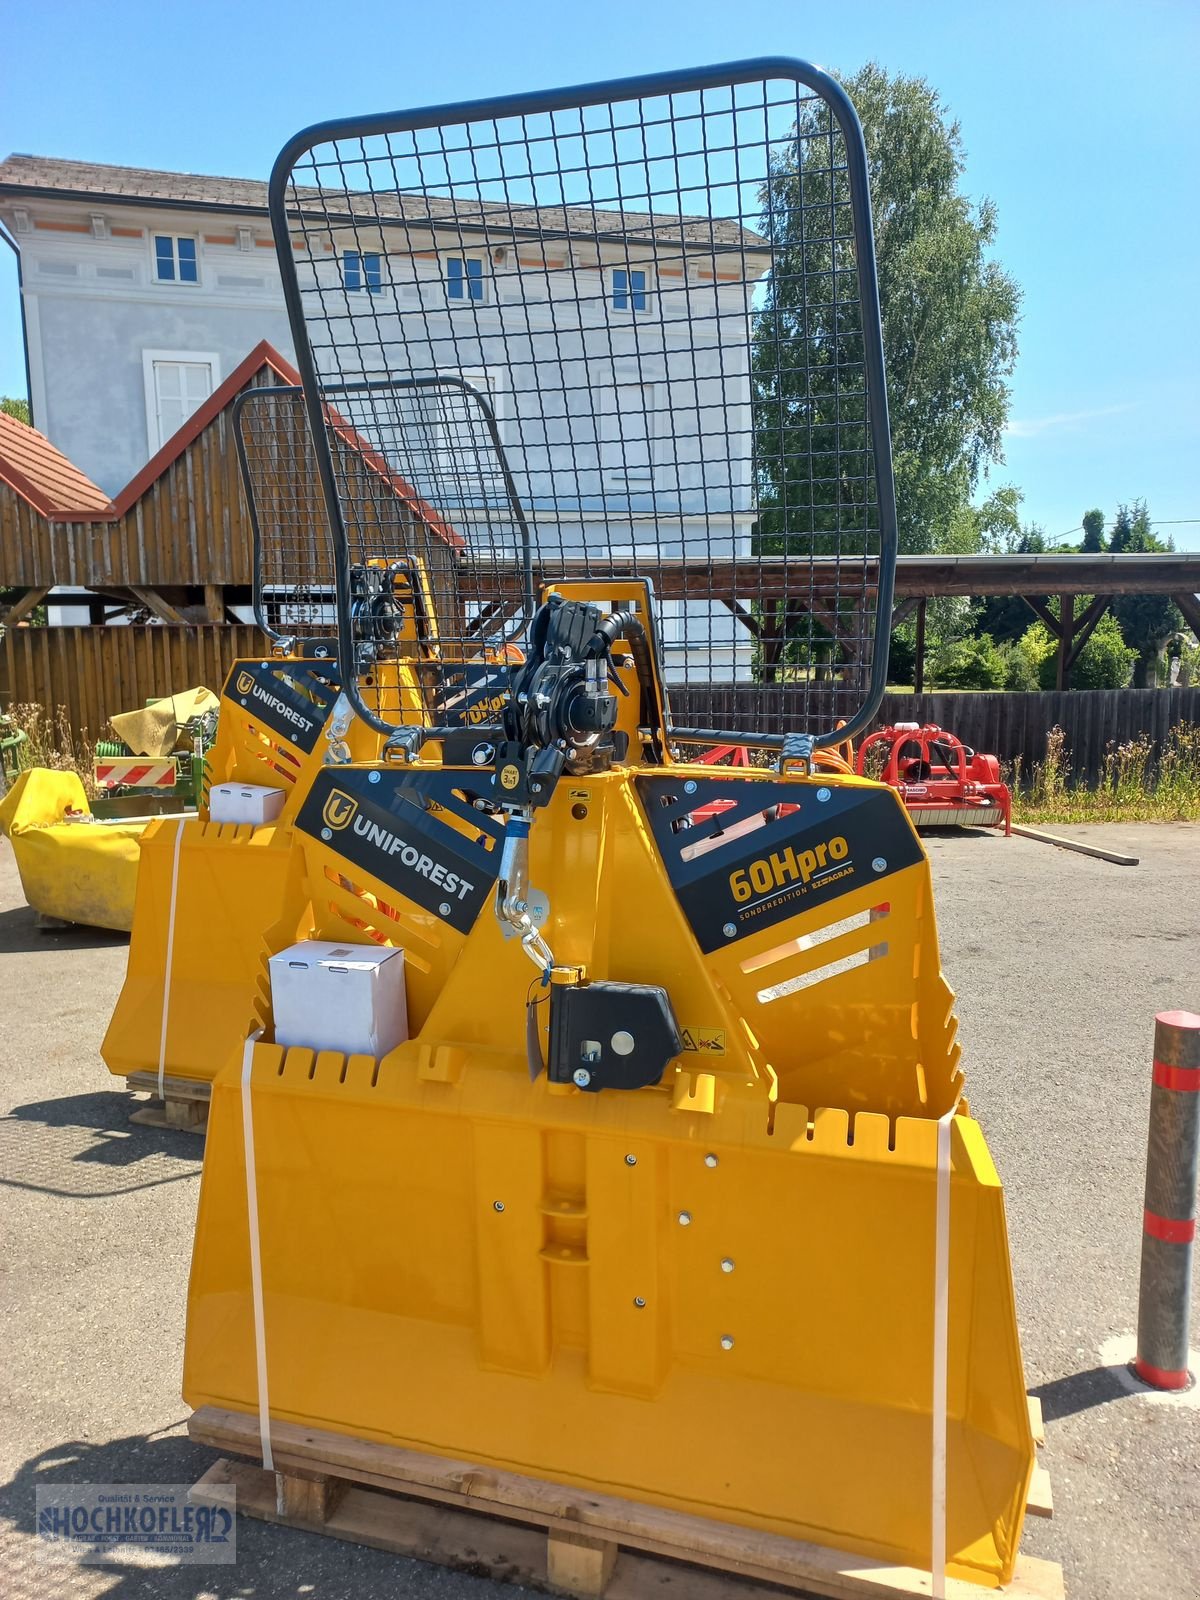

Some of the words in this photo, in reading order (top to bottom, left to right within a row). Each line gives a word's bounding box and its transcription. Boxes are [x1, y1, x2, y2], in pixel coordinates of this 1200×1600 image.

[252, 684, 314, 732] UNIFOREST
[353, 814, 474, 900] UNIFOREST
[729, 836, 849, 903] 60Hpro
[739, 886, 808, 921] SONDEREDITION
